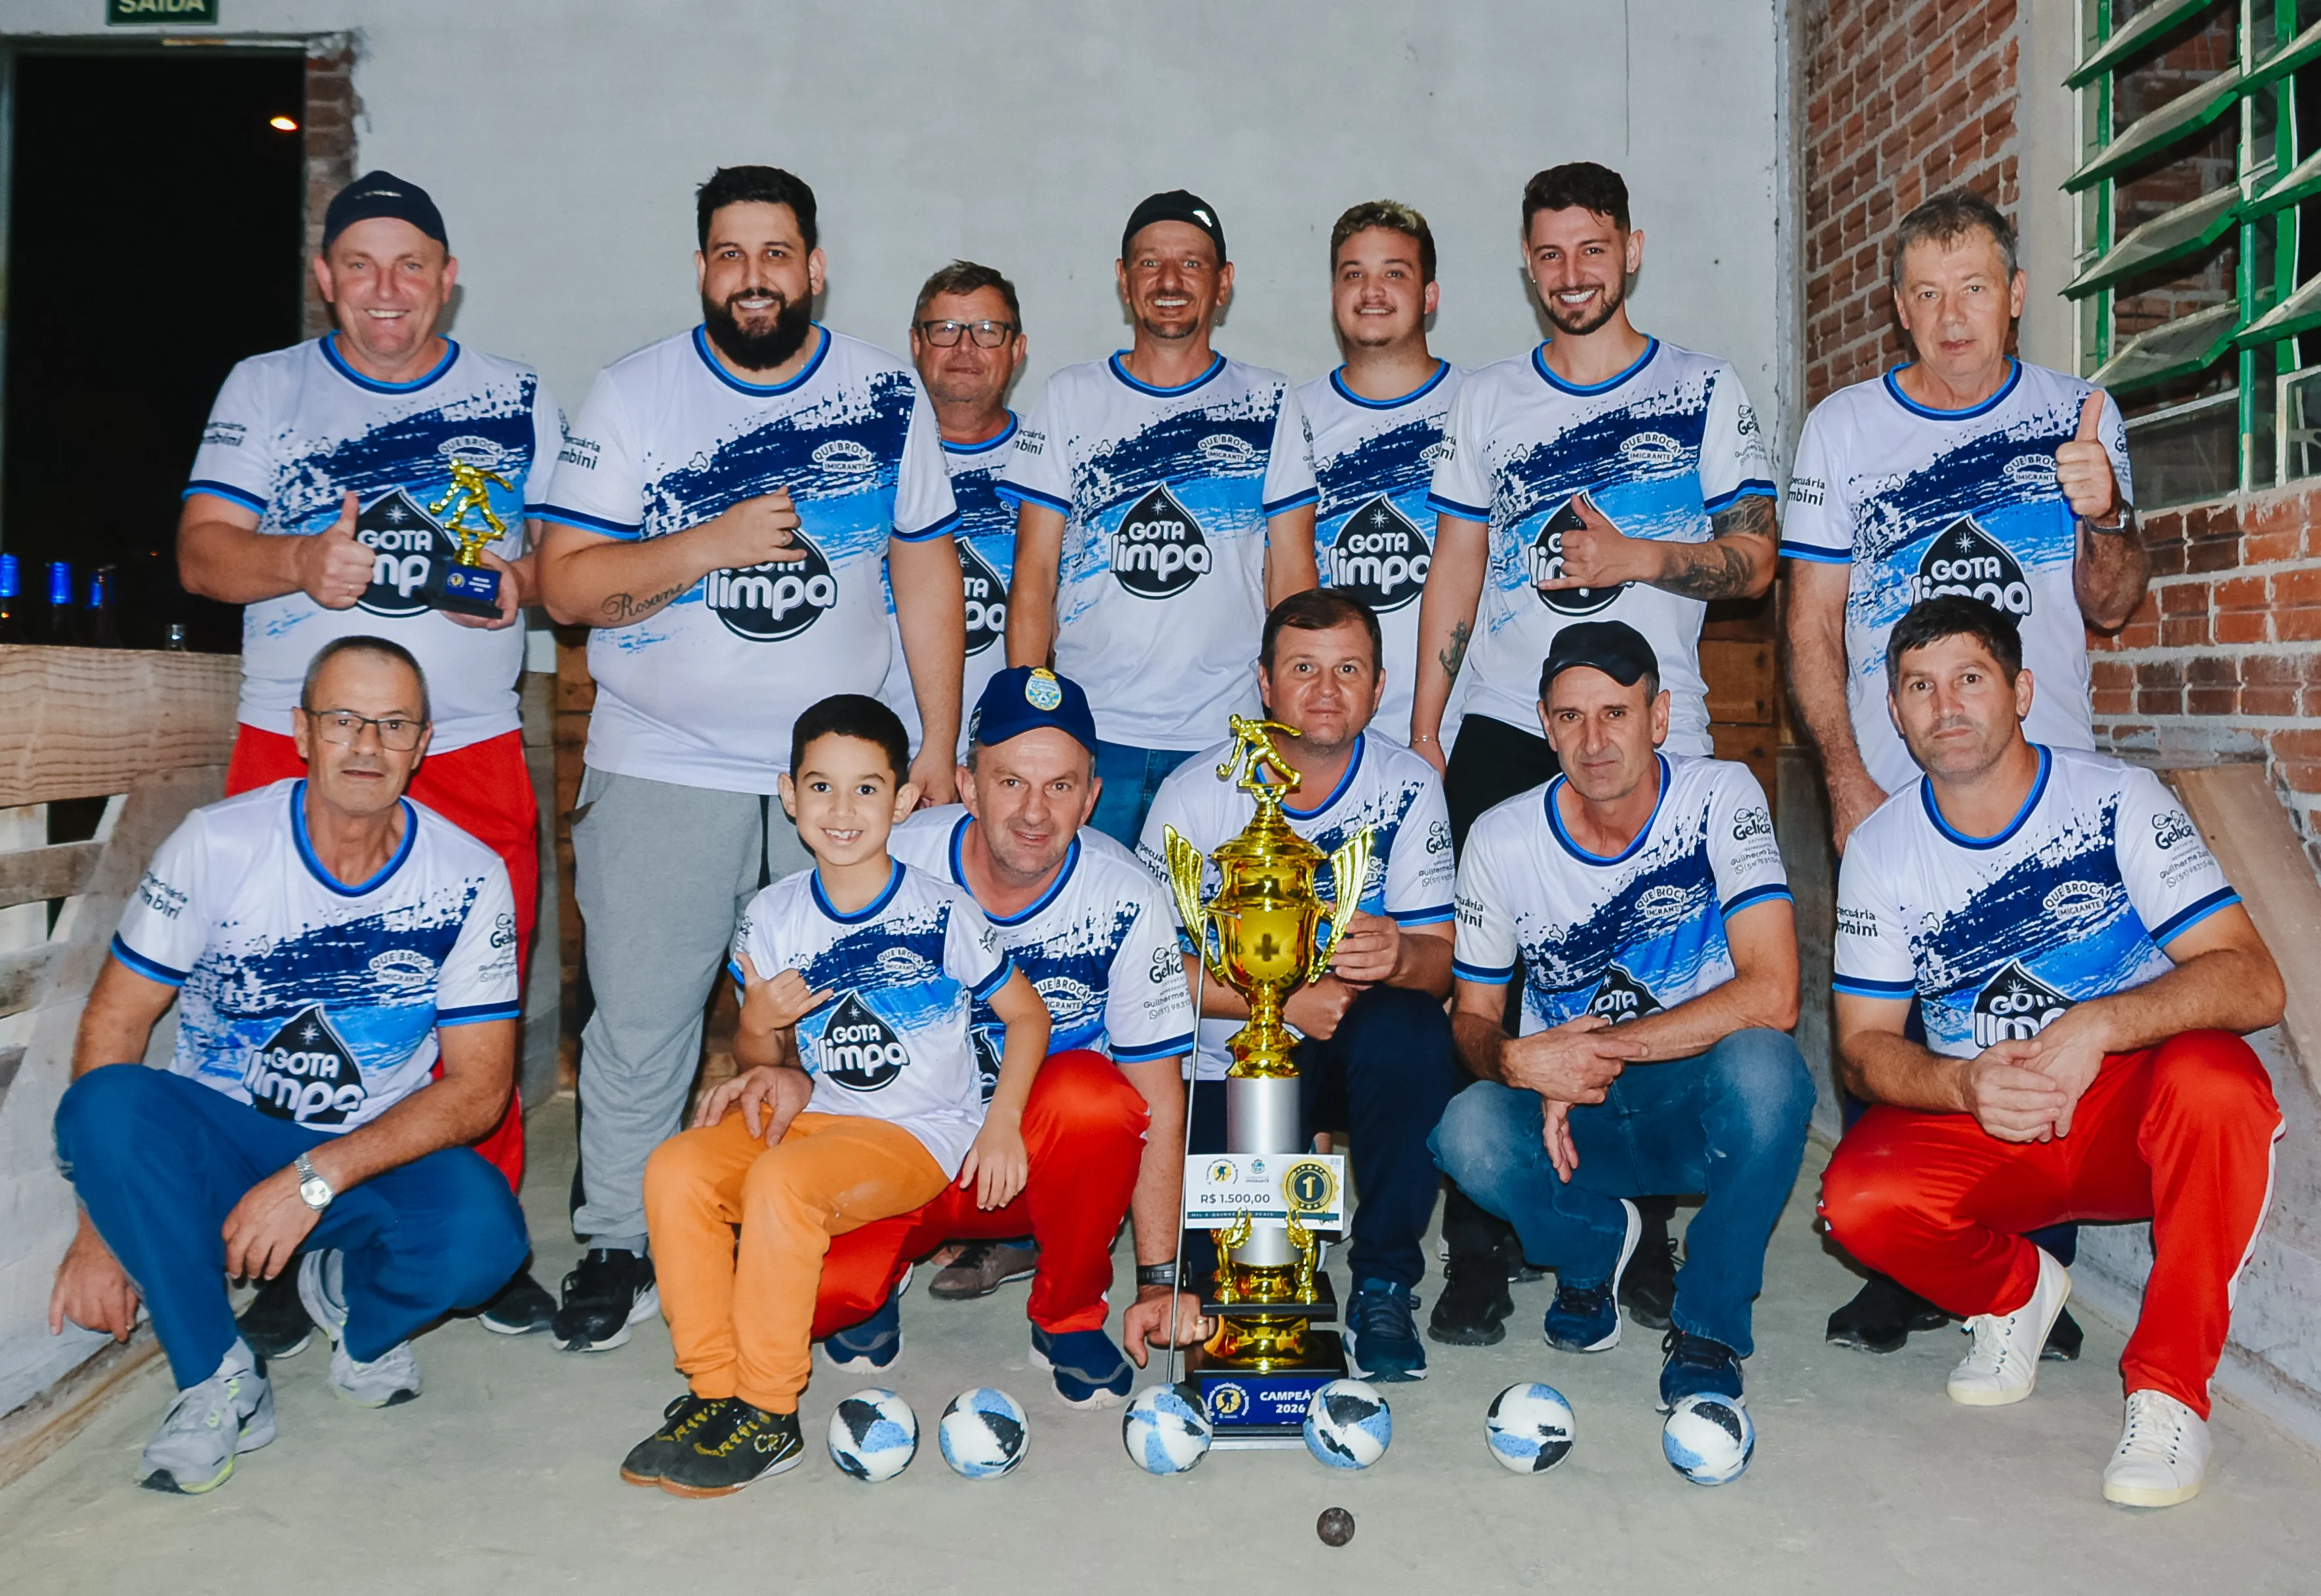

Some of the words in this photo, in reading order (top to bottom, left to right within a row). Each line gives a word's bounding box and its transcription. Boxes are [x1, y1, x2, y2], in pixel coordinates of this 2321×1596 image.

[814, 444, 835, 460] QUE
[837, 443, 869, 462] BROCA
[1200, 436, 1218, 449] QUE
[1221, 436, 1250, 455] BROCA
[1622, 435, 1642, 450] QUE
[1645, 434, 1678, 454] BROCA
[1208, 451, 1244, 461] IMIGRANTE
[2006, 458, 2025, 473] QUE
[2028, 456, 2057, 468] BROC
[1788, 488, 1824, 506] mbini
[357, 529, 433, 551] GOTA
[1129, 521, 1185, 542] GOTA
[1348, 532, 1409, 553] GOTA
[1111, 534, 1212, 582] limpa
[1931, 556, 2002, 582] GOTA
[707, 569, 837, 621] limpa
[962, 577, 989, 598] TA
[1637, 892, 1655, 908] QUE
[2045, 888, 2065, 908] QUE
[2065, 883, 2105, 898] BROCA
[1837, 920, 1878, 938] mbini
[372, 953, 395, 968] QUE
[879, 949, 896, 961] QUE
[1038, 980, 1054, 992] UE
[1056, 979, 1088, 999] BROCA
[1046, 1001, 1081, 1010] IGRANTE
[1143, 991, 1185, 1008] Guilherme
[1591, 989, 1638, 1014] OTA
[832, 1024, 881, 1044] GOTA
[269, 1047, 340, 1079] GOTA
[818, 1038, 909, 1077] limpa
[1200, 1193, 1216, 1205] R$
[1220, 1193, 1271, 1205] 1.500,00
[1260, 1389, 1314, 1401] CAMPEÃ
[1275, 1403, 1306, 1414] 2026
[753, 1431, 789, 1453] CR7
